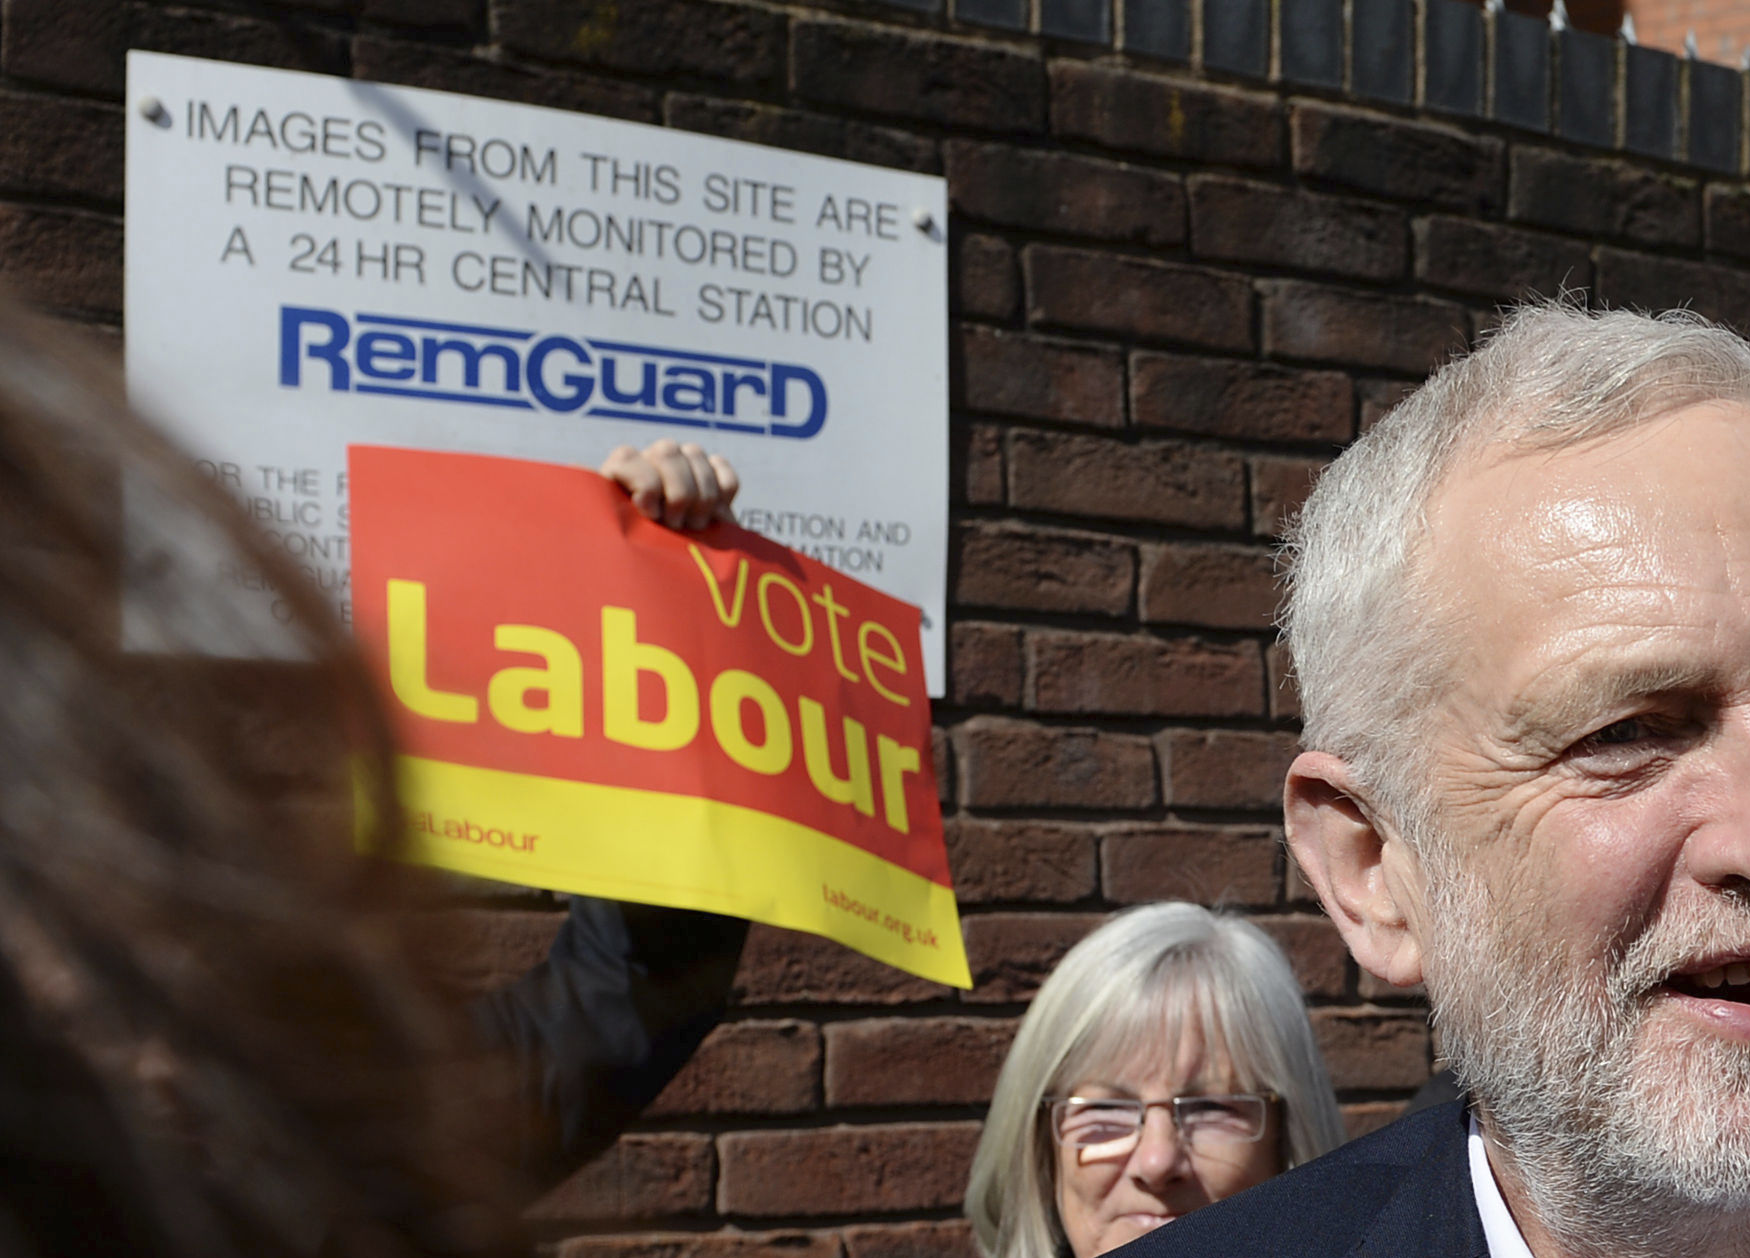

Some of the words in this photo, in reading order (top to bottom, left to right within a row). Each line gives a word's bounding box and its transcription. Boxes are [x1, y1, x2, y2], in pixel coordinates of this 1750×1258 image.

[186, 100, 387, 161] IMAGES
[415, 130, 558, 186] FROM
[580, 153, 681, 203] THIS
[704, 172, 795, 224] SITE
[816, 194, 901, 240] ARE
[225, 166, 502, 235] REMOTELY
[527, 205, 797, 278] MONITORED
[820, 242, 872, 286] BY
[220, 225, 255, 267] A
[452, 251, 674, 315] CENTRAL
[698, 286, 874, 342] STATION
[193, 459, 242, 488] OR
[256, 465, 322, 497] THE
[739, 508, 845, 540] VENTION
[857, 519, 912, 547] AND
[247, 497, 322, 528] BLIC
[263, 530, 350, 560] CONT
[387, 578, 920, 834] Labour
[428, 812, 541, 853] Labour
[822, 882, 941, 950] labour.org.uk
